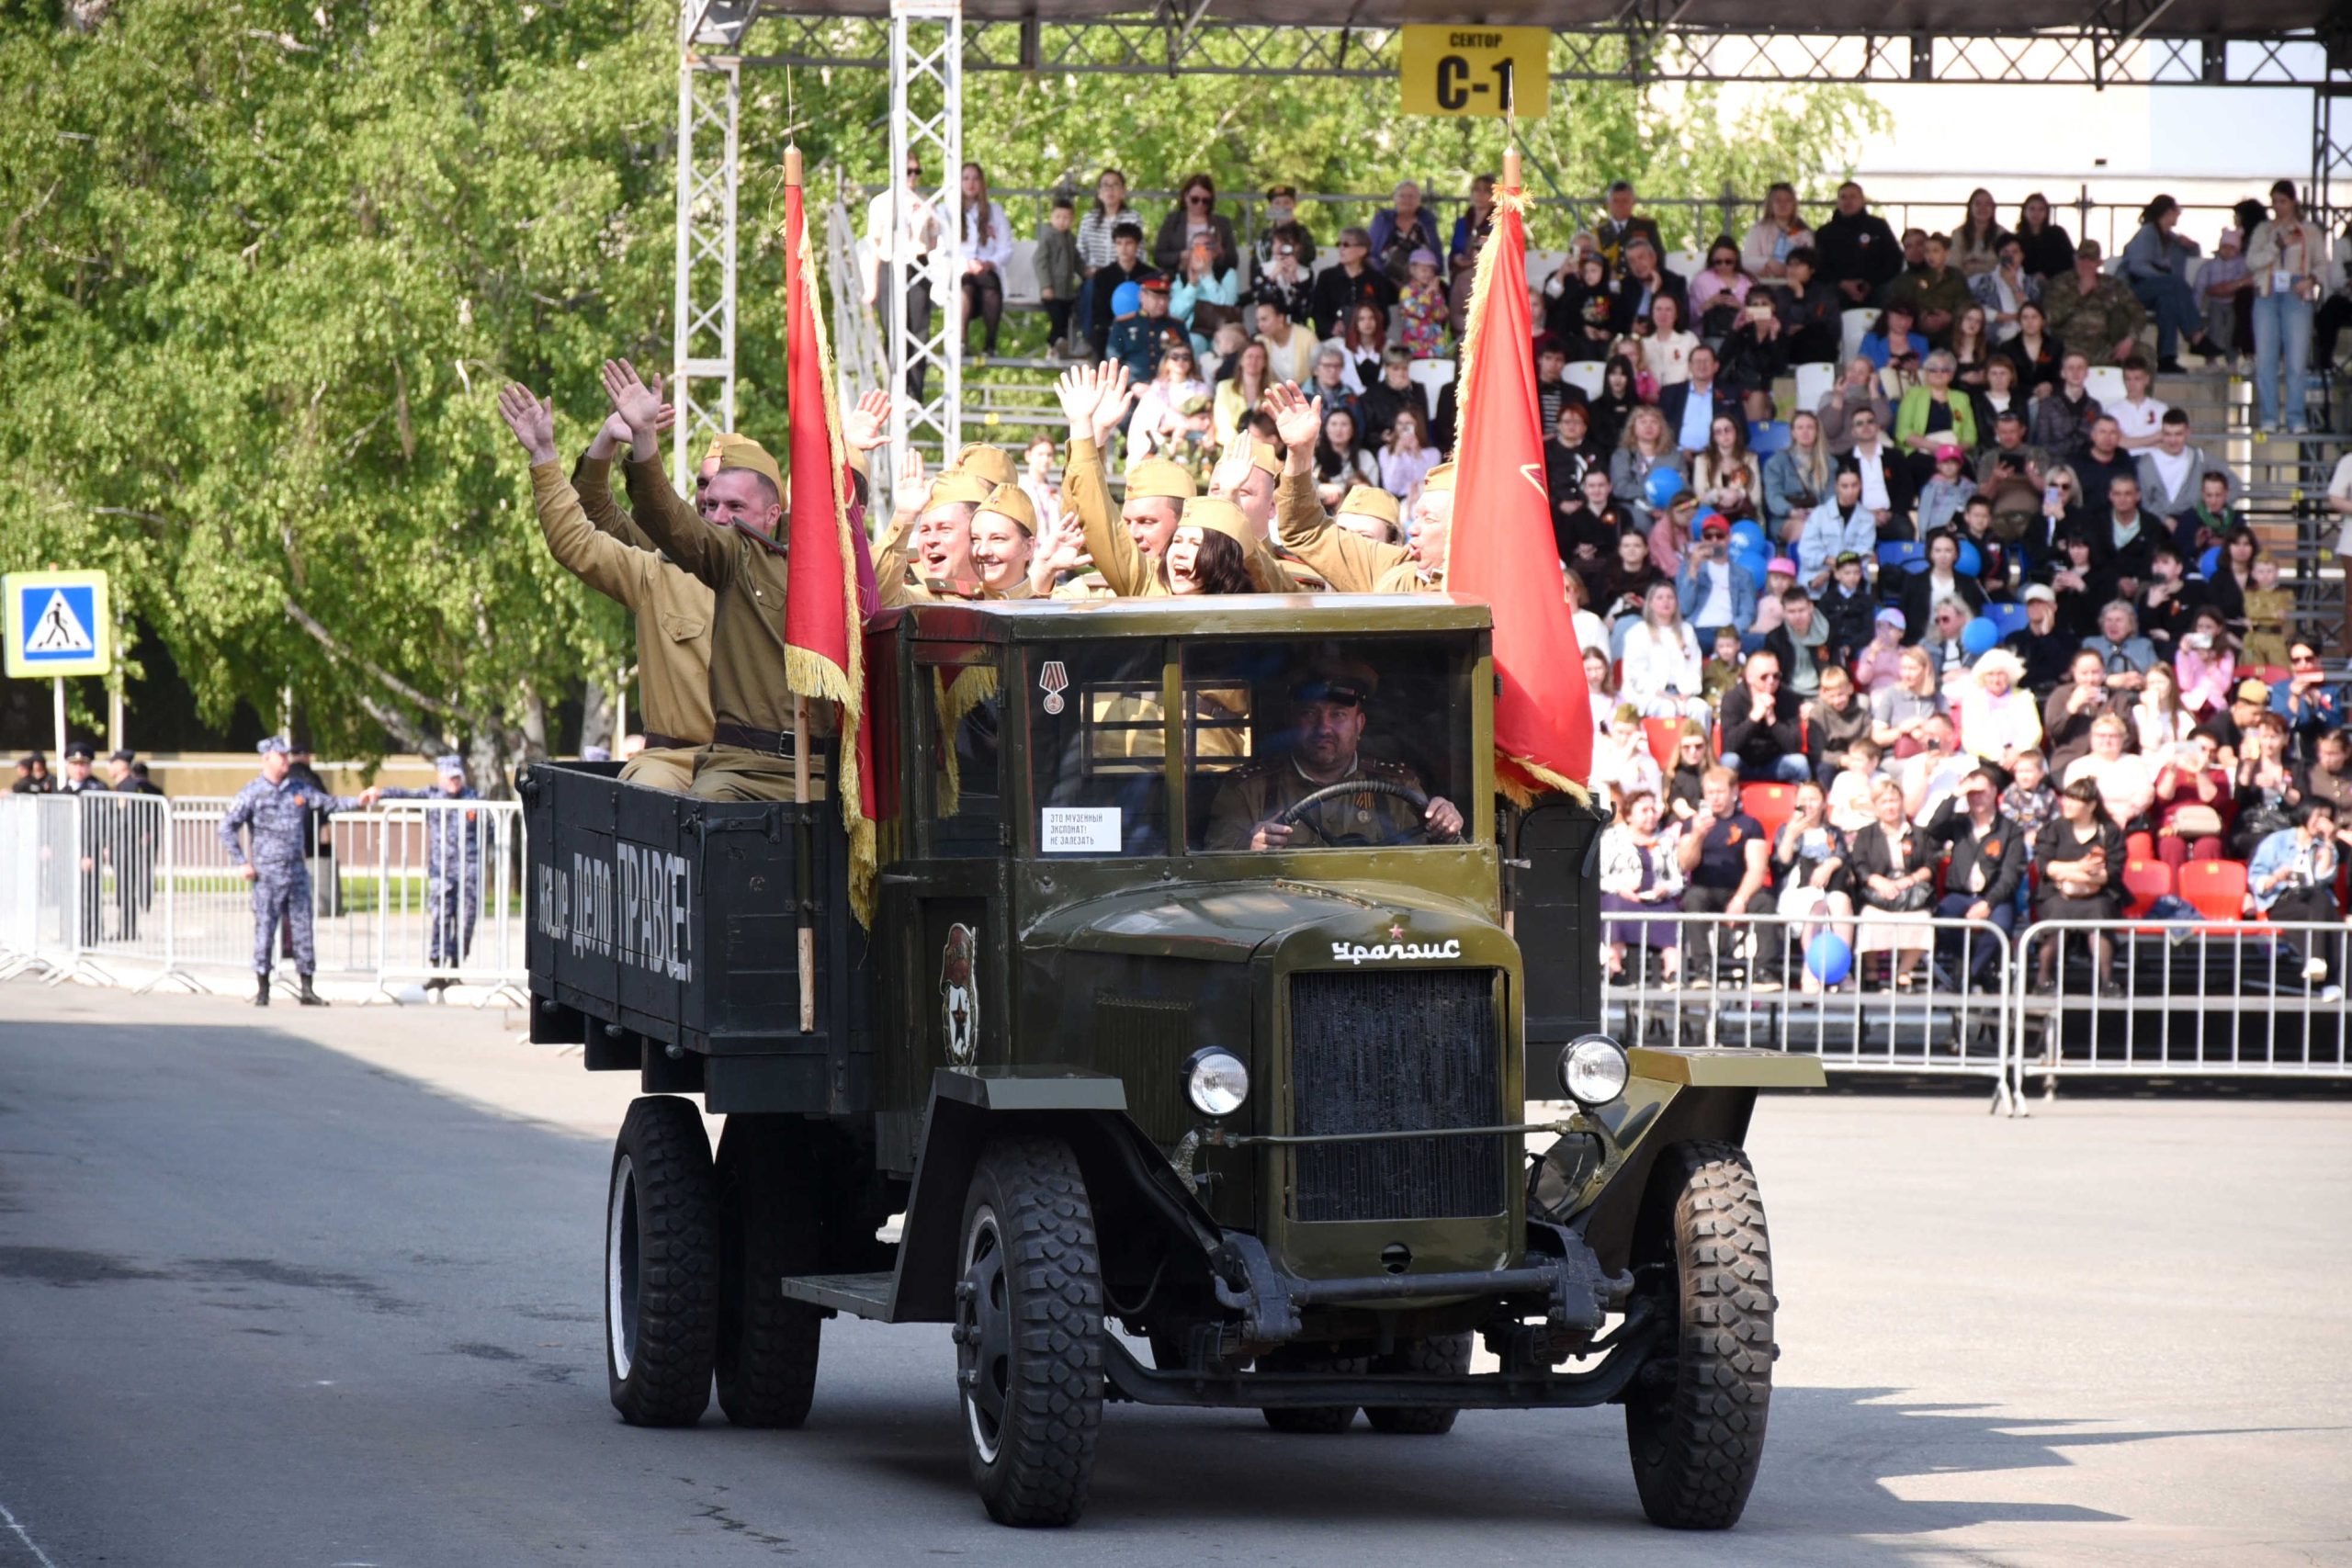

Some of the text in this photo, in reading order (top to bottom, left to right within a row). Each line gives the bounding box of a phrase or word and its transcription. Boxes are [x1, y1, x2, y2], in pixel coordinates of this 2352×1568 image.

[1450, 33, 1502, 48] СЕКТОР
[1437, 55, 1514, 110] С-1
[1050, 814, 1063, 823] ЭТО
[1050, 825, 1087, 834] ЭКСПОНАТ!
[1050, 836, 1094, 845] НЕ ЗАЛЕЗАТЬ
[616, 841, 692, 984] ПРАВОЕ!
